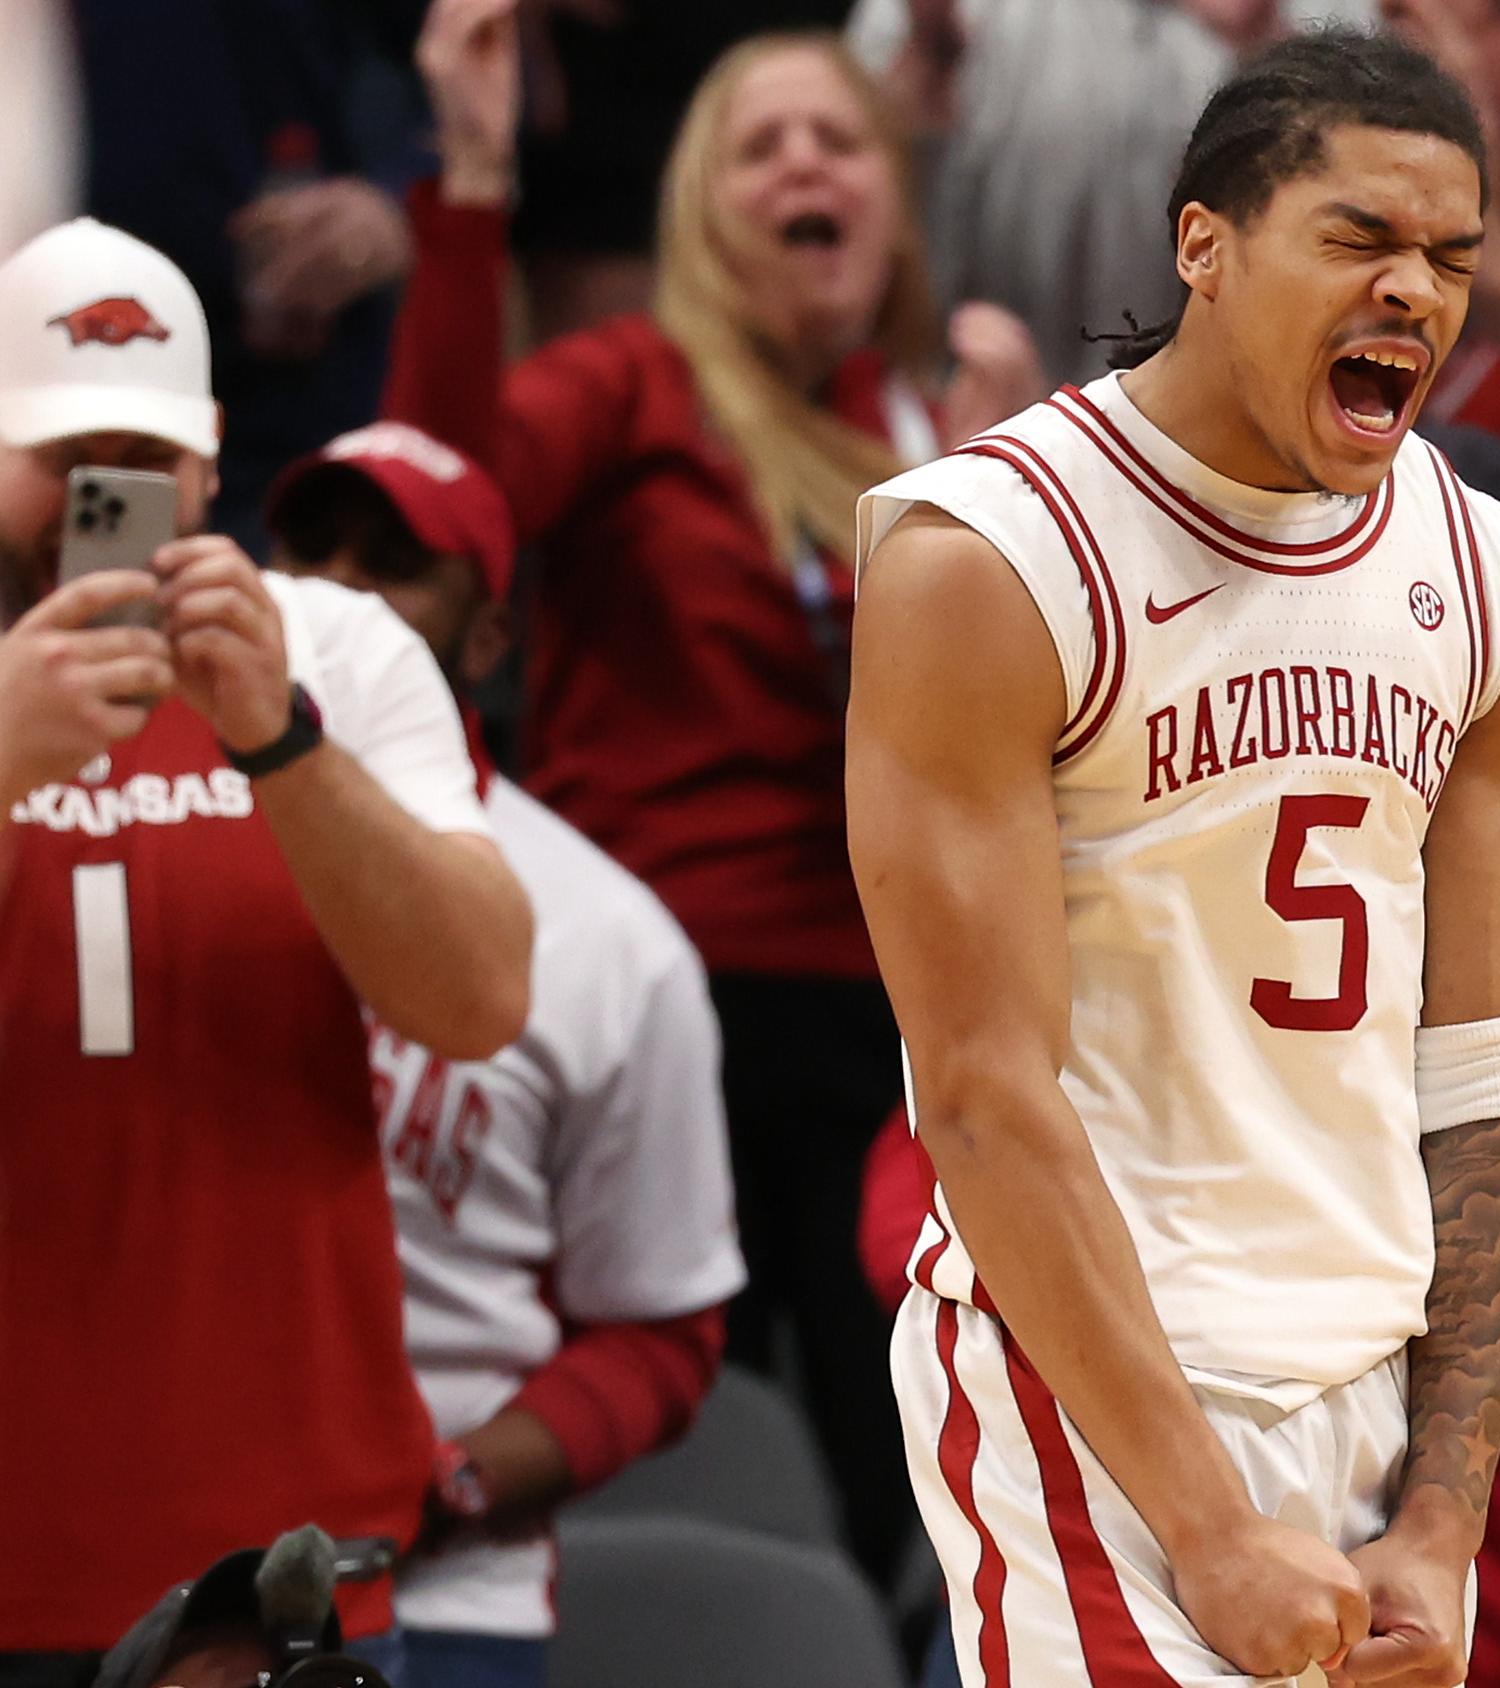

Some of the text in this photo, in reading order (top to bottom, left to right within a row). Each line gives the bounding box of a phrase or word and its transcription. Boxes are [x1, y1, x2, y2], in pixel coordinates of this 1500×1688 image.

[1410, 583, 1443, 627] SEC
[11, 768, 254, 837] KANSAS
[1144, 665, 1456, 813] RAZORBACKS
[72, 862, 135, 1057] 1
[1250, 794, 1370, 1031] 5
